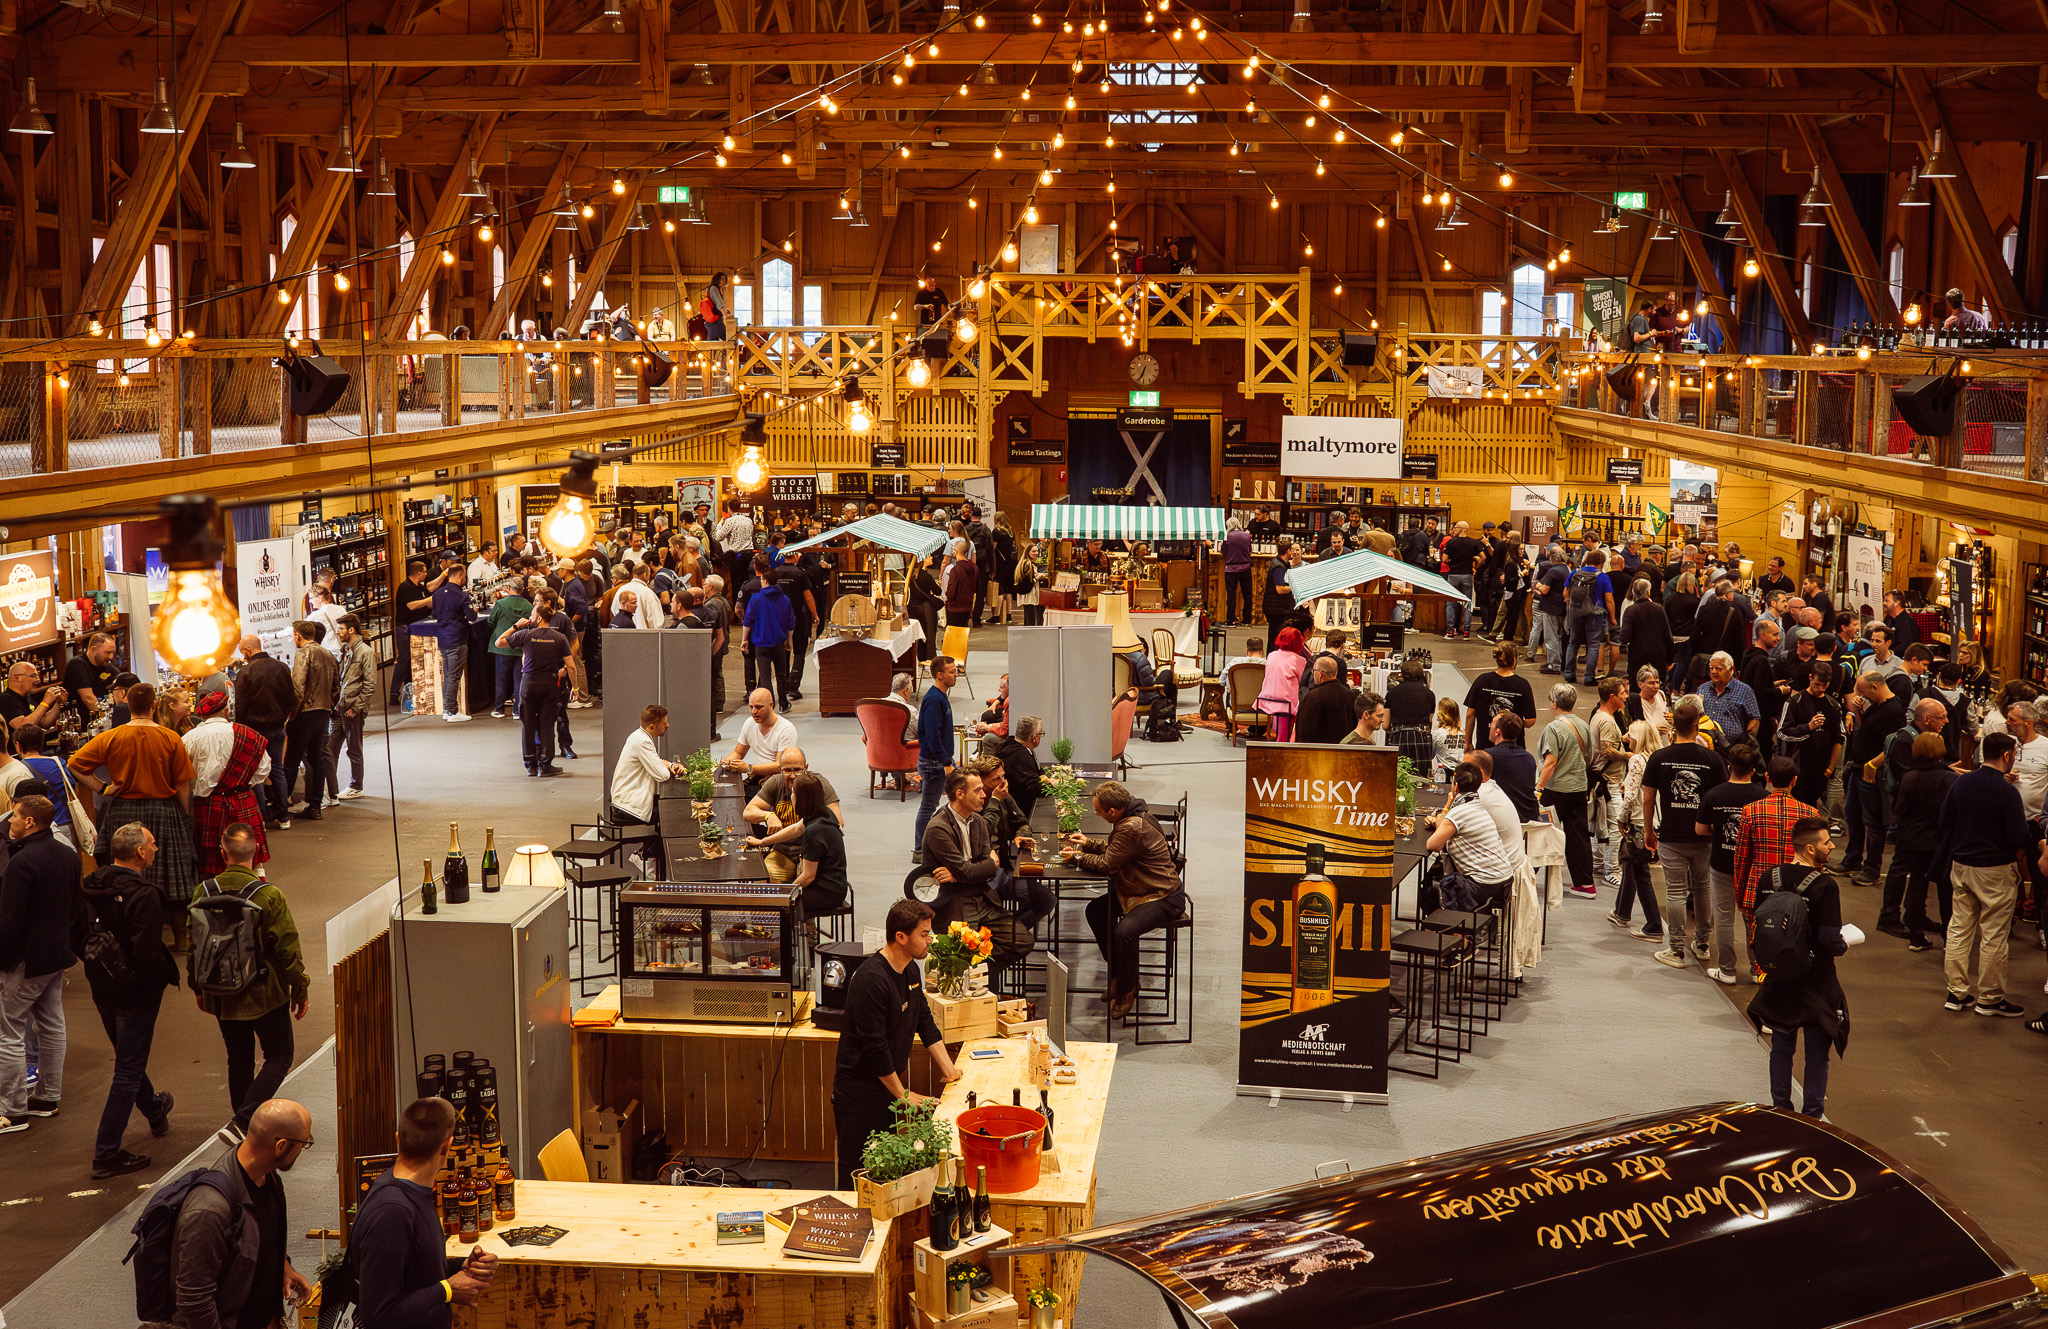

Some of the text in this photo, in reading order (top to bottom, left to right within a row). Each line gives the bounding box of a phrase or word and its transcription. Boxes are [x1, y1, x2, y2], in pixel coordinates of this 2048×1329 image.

[1602, 304, 1622, 320] OPEN
[1124, 417, 1166, 425] Garderobe
[1036, 449, 1062, 458] Tastings
[1286, 436, 1396, 458] maltymore
[1856, 560, 1876, 575] avril
[254, 574, 280, 589] WHISKY
[248, 598, 290, 614] ONLINE-SHOP
[1252, 778, 1363, 804] WHISKY
[1333, 804, 1389, 827] Time
[1300, 916, 1329, 925] BUSHMILLS
[1282, 1040, 1346, 1051] MEDIENBOTSCHAFT
[480, 1089, 496, 1097] EADIE
[1758, 1156, 1857, 1201] Die
[1423, 1156, 1673, 1222] der exquisiten
[1537, 1175, 1770, 1250] Chocolaterie
[806, 1234, 839, 1245] BURN
[811, 1226, 856, 1238] WHISKY
